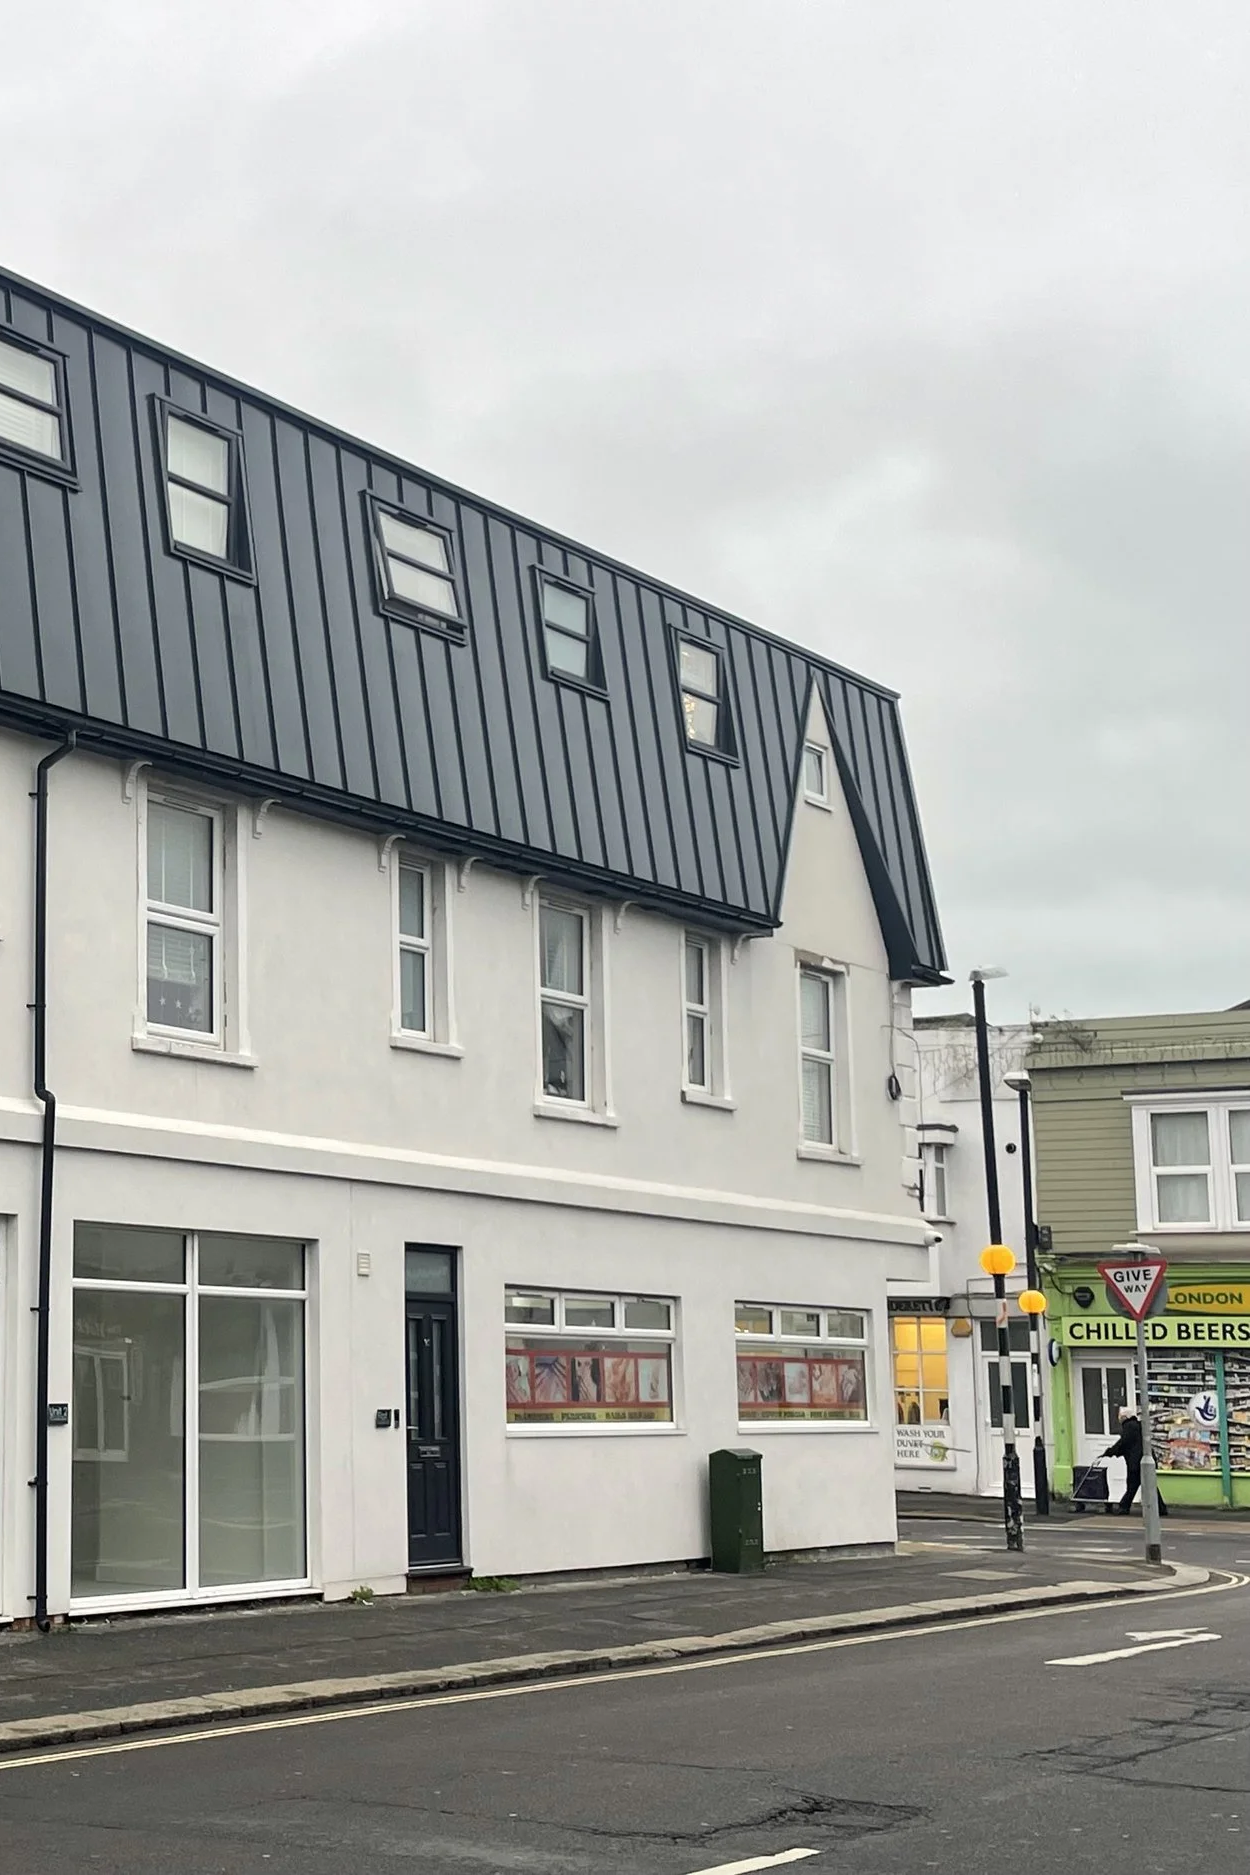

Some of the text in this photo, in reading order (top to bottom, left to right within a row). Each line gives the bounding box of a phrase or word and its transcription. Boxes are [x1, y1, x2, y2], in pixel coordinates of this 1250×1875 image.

[1113, 1269, 1153, 1283] GIVE
[1124, 1284, 1148, 1294] WAY
[1167, 1292, 1243, 1304] LONDON
[1177, 1323, 1250, 1341] BEERS
[896, 1429, 946, 1439] WASH YOUR
[896, 1450, 920, 1458] HERE
